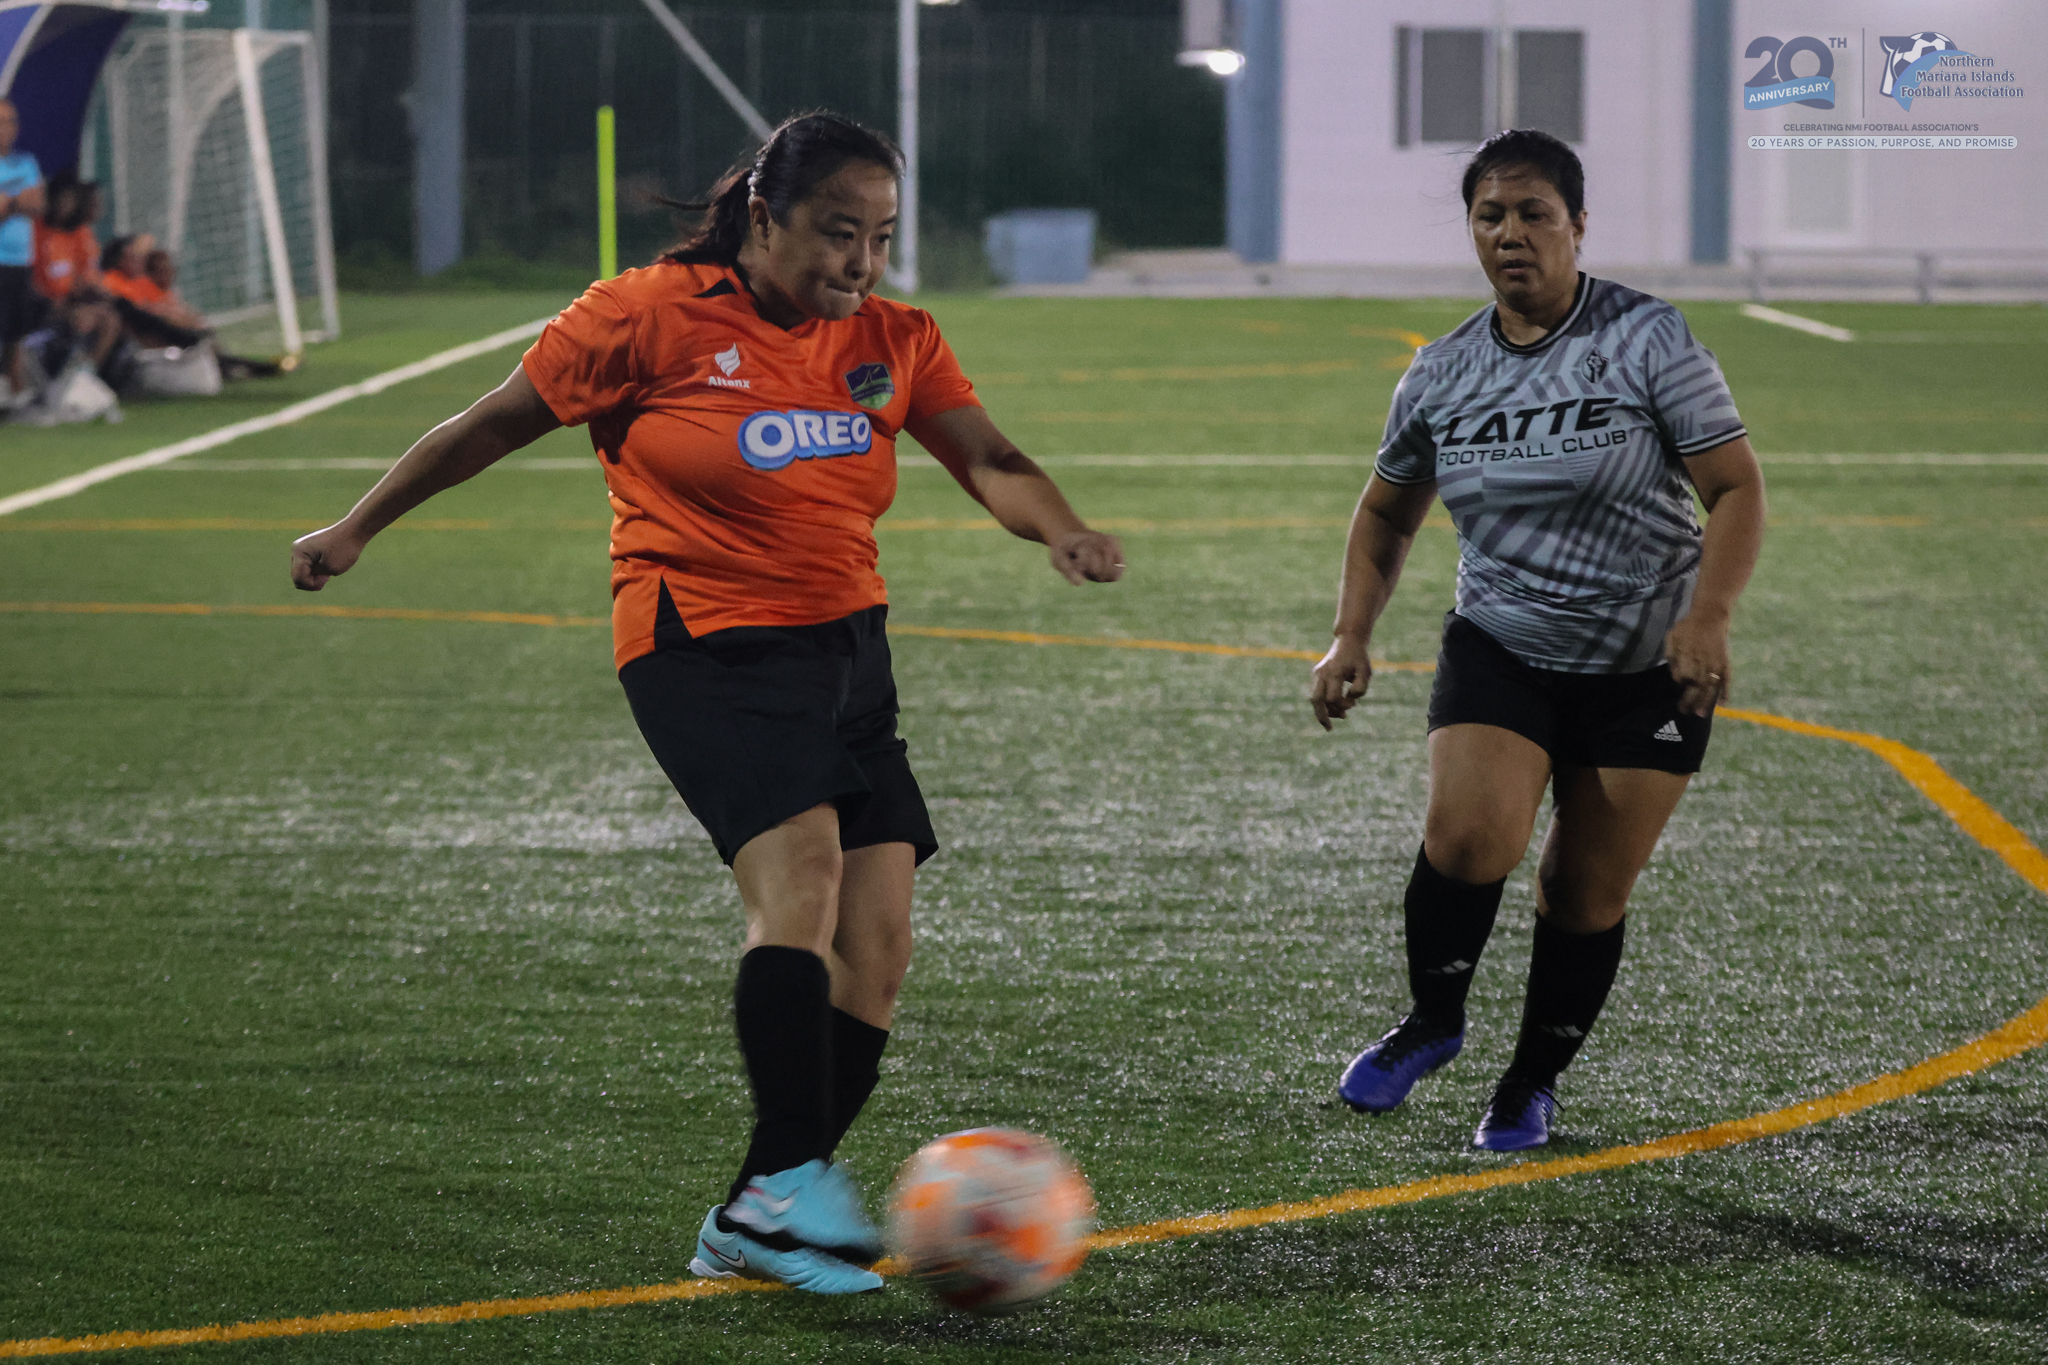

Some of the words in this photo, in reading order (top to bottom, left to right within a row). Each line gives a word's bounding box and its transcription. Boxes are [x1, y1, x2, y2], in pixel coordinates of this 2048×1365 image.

[745, 414, 870, 458] OREO
[1441, 397, 1619, 447] LATTE
[1561, 429, 1627, 453] CLUB
[1653, 732, 1683, 742] adidas
